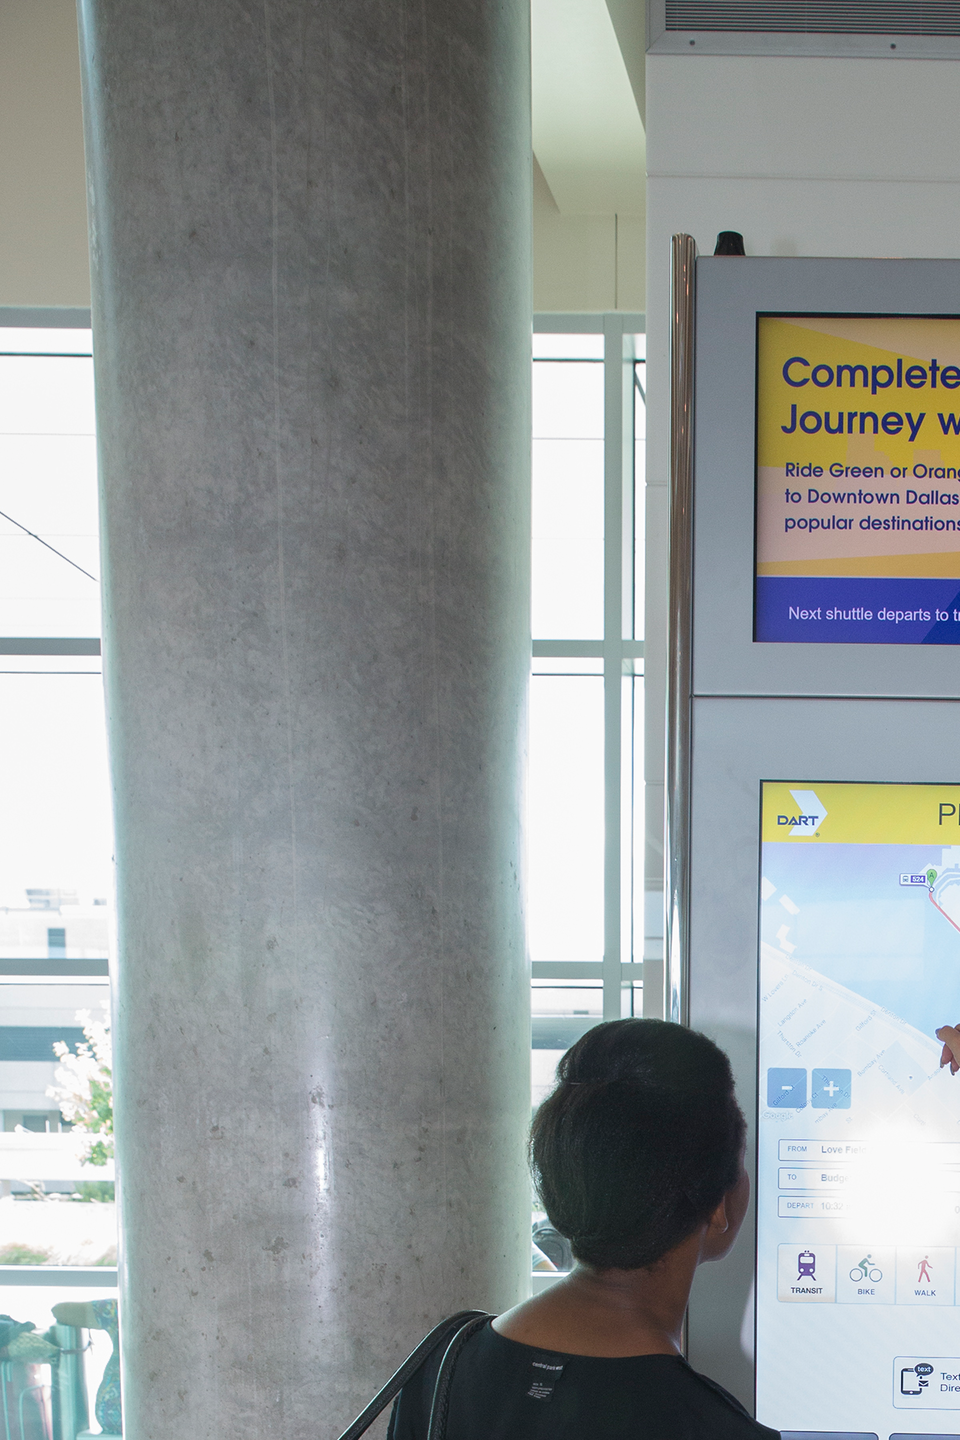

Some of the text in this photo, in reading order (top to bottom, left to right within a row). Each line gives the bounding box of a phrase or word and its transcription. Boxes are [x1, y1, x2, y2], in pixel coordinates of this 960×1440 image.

[781, 404, 925, 442] Journey
[785, 462, 824, 478] Ride
[829, 463, 884, 479] Green
[889, 467, 908, 479] or
[785, 490, 802, 504] to
[807, 488, 901, 506] Downtown
[906, 489, 960, 506] Dallas
[784, 514, 853, 534] popular
[788, 607, 822, 621] Next
[826, 607, 873, 622] shuttle
[877, 607, 931, 625] departs
[935, 609, 949, 622] to
[777, 815, 819, 826] DART
[912, 875, 924, 883] 524
[821, 1146, 843, 1154] Love
[787, 1173, 797, 1181] TO
[820, 1173, 852, 1184] Budge
[820, 1202, 844, 1210] 10:32
[791, 1286, 824, 1295] TRANSIT
[857, 1287, 876, 1296] BIKE
[914, 1289, 937, 1297] WALK
[917, 1365, 933, 1373] text
[940, 1372, 960, 1382] Text
